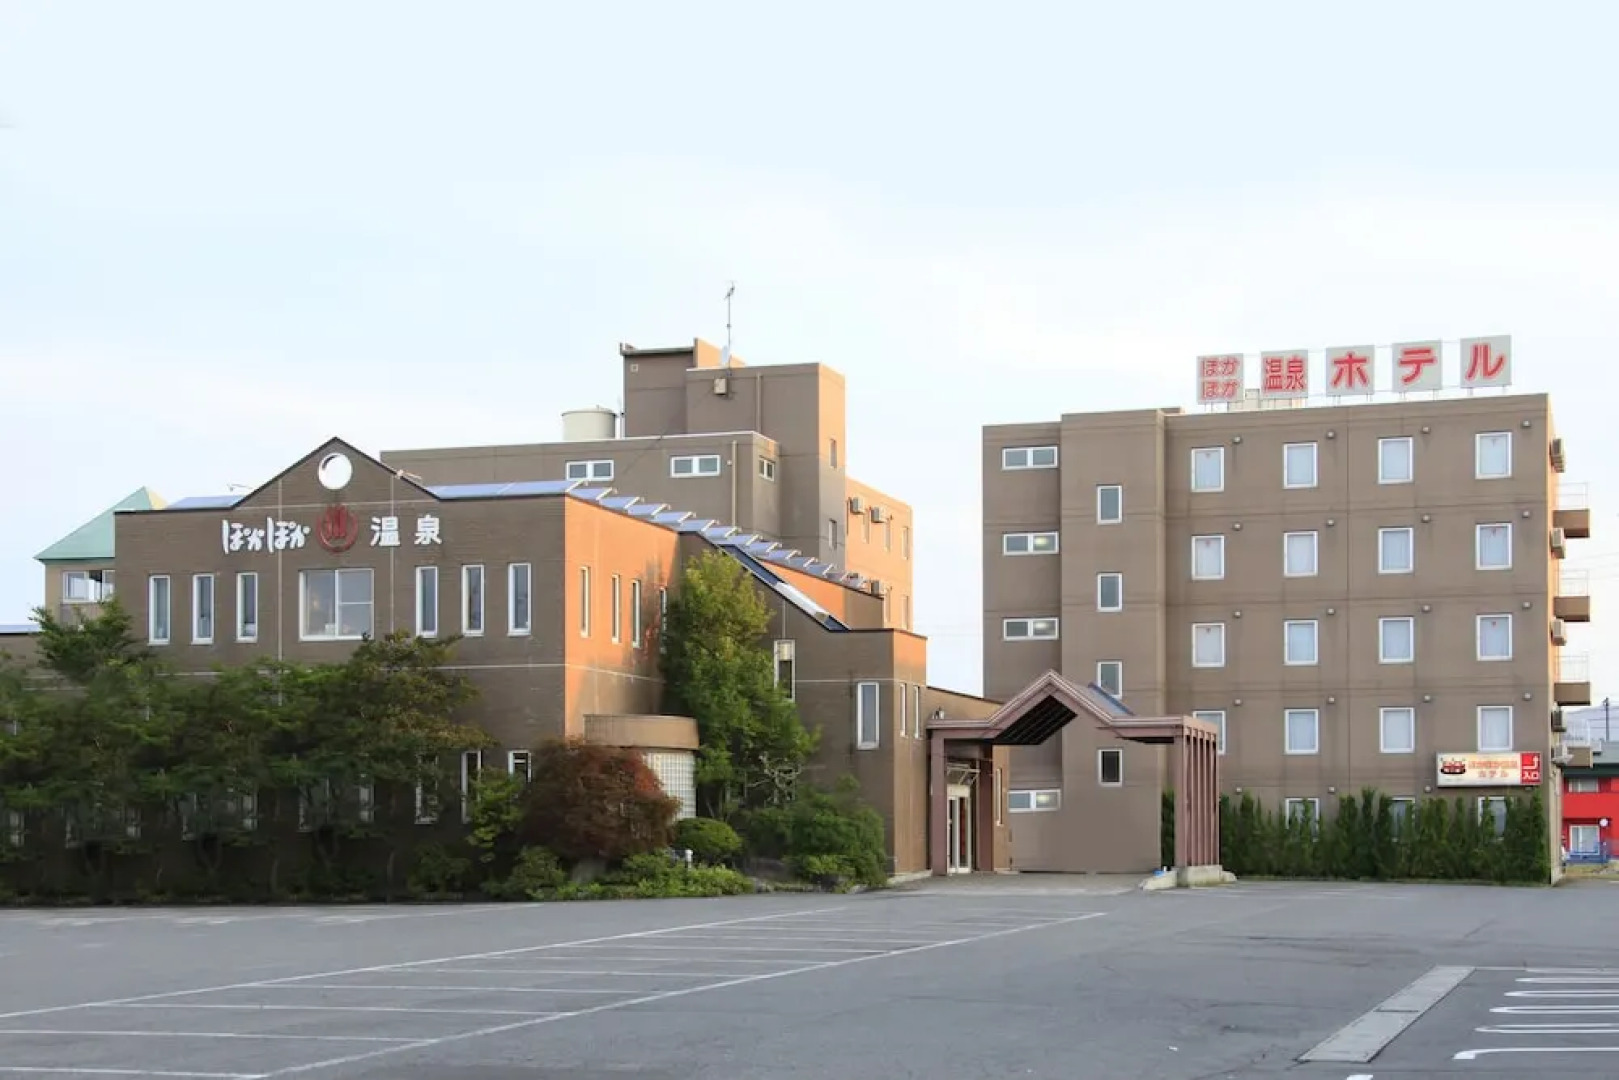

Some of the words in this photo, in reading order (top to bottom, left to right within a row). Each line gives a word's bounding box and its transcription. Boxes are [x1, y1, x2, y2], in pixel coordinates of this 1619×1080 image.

[1264, 355, 1305, 391] 温泉
[1331, 343, 1506, 389] ホテル
[222, 517, 311, 554] ぽかぽか
[370, 515, 442, 547] 温泉
